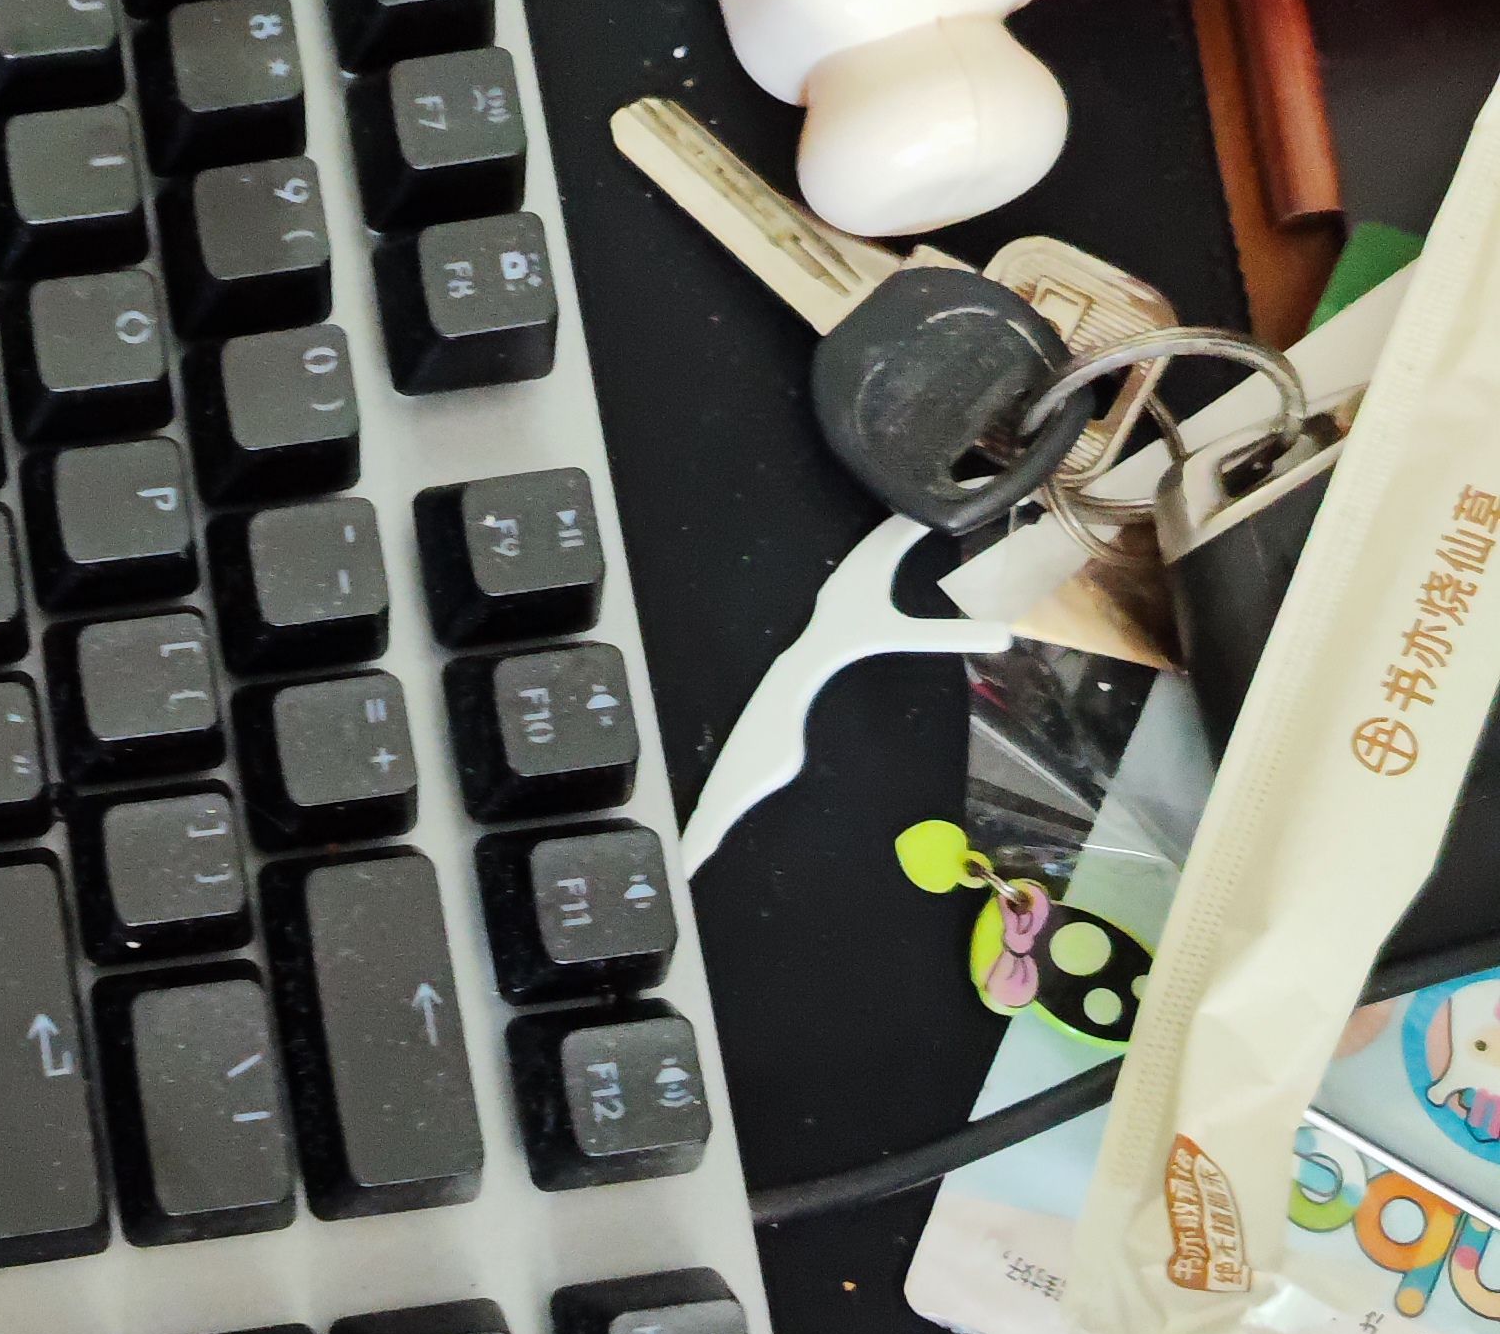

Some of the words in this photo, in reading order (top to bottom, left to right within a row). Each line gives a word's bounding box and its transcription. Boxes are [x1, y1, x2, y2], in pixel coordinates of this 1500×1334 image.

[249, 12, 283, 40] 8
[414, 94, 448, 131] F7
[273, 178, 308, 205] 9
[444, 260, 478, 299] F8
[115, 309, 155, 345] O
[303, 346, 339, 374] 0
[136, 486, 179, 512] P
[482, 517, 522, 557] F9
[1380, 483, 1500, 713] 书亦烧仙草
[517, 687, 556, 745] F10
[556, 877, 596, 928] F11
[586, 1061, 627, 1123] F12
